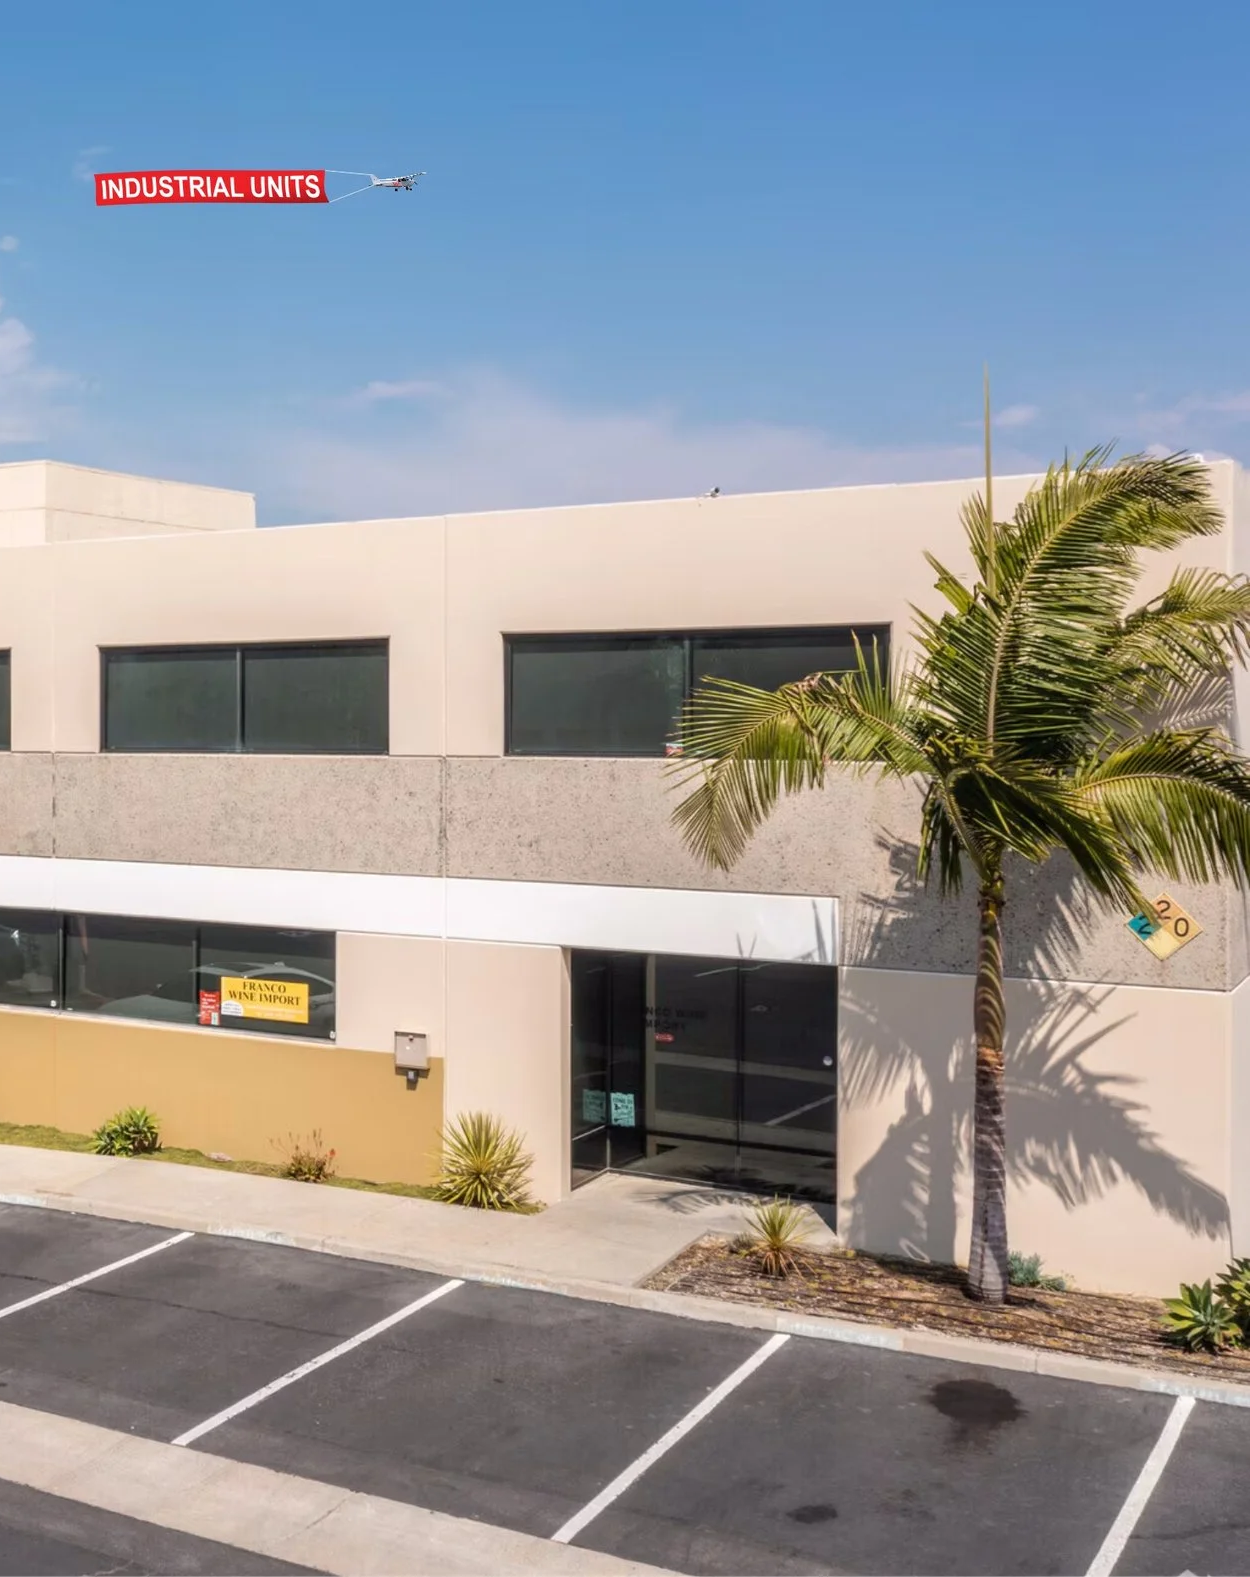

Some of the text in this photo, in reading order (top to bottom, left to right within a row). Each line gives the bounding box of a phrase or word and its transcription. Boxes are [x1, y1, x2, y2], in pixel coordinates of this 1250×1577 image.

[101, 175, 320, 200] INDUSTRIAL UNITS
[1157, 900, 1171, 919] 2
[1174, 917, 1189, 937] 0
[243, 981, 286, 993] FRANCO
[229, 990, 301, 1006] WINE IMPORT
